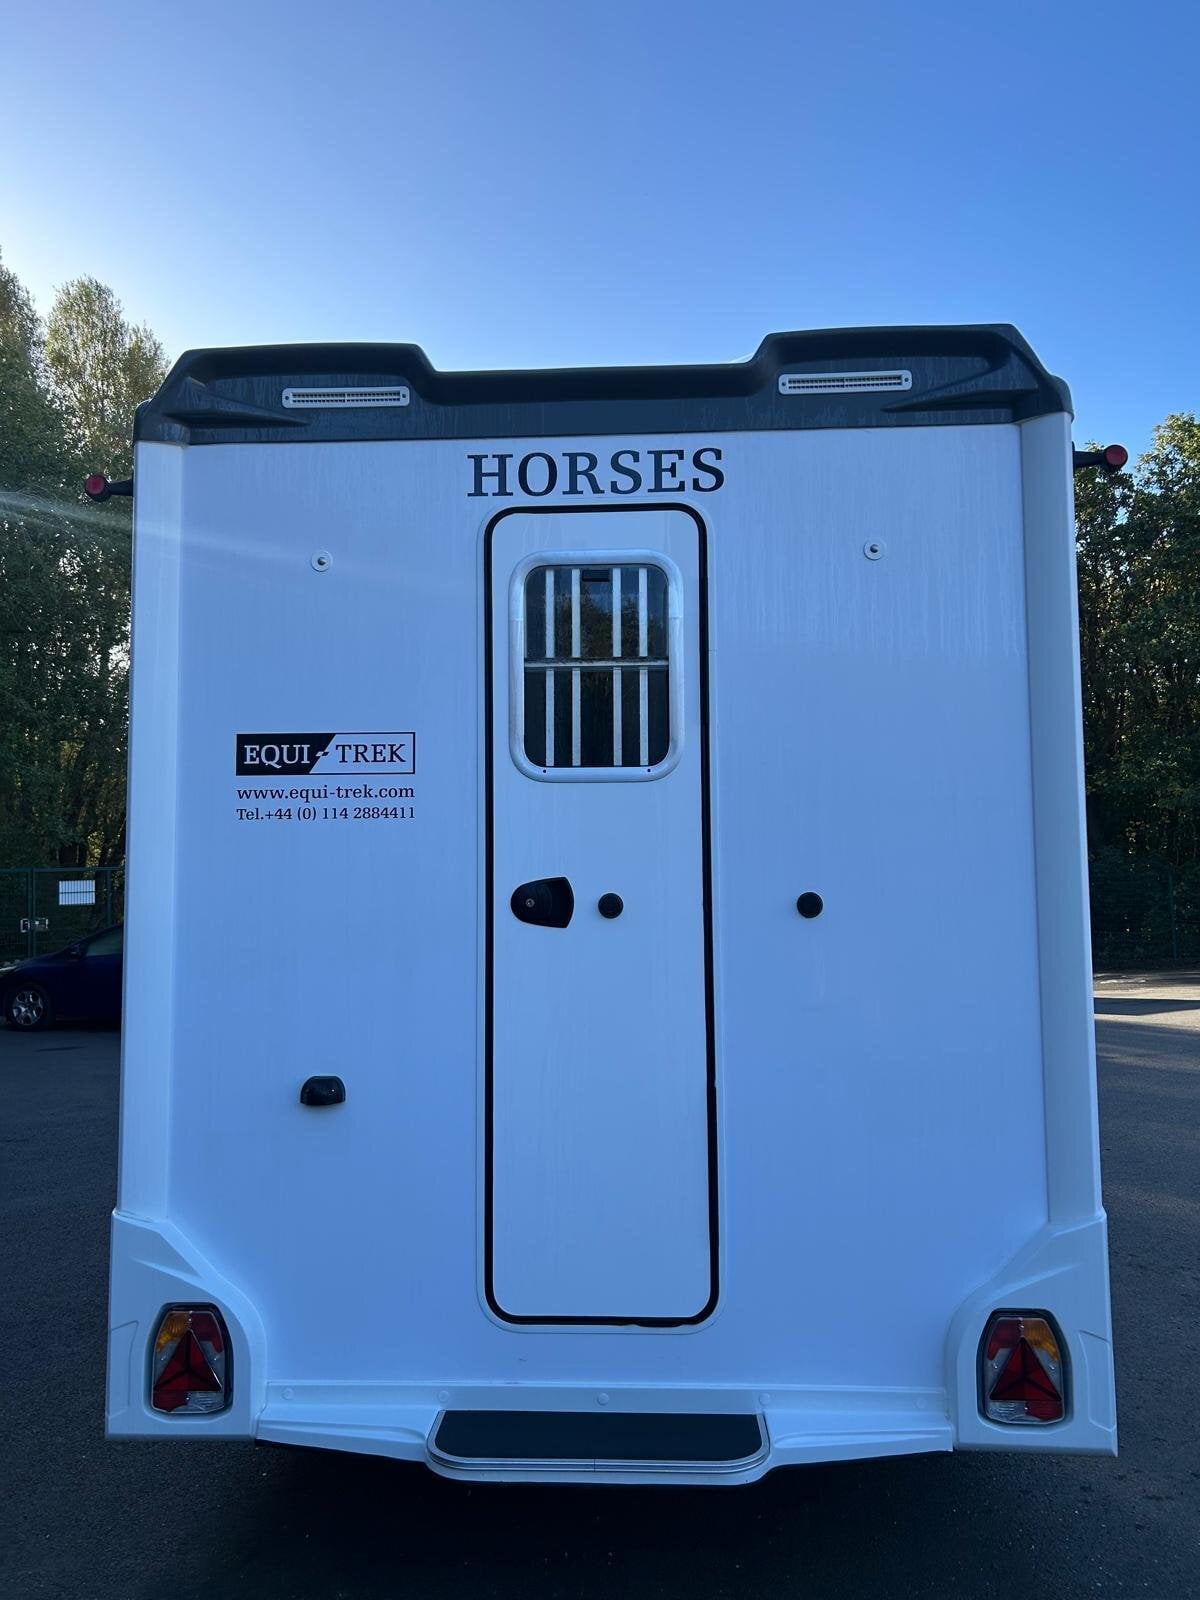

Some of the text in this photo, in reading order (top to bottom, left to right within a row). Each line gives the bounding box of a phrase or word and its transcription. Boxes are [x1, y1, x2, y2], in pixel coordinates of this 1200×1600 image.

[467, 447, 725, 497] HORSES
[237, 784, 415, 803] www.equi-trek.com
[237, 807, 415, 821] Tel.+44 (0) 114 2884411
